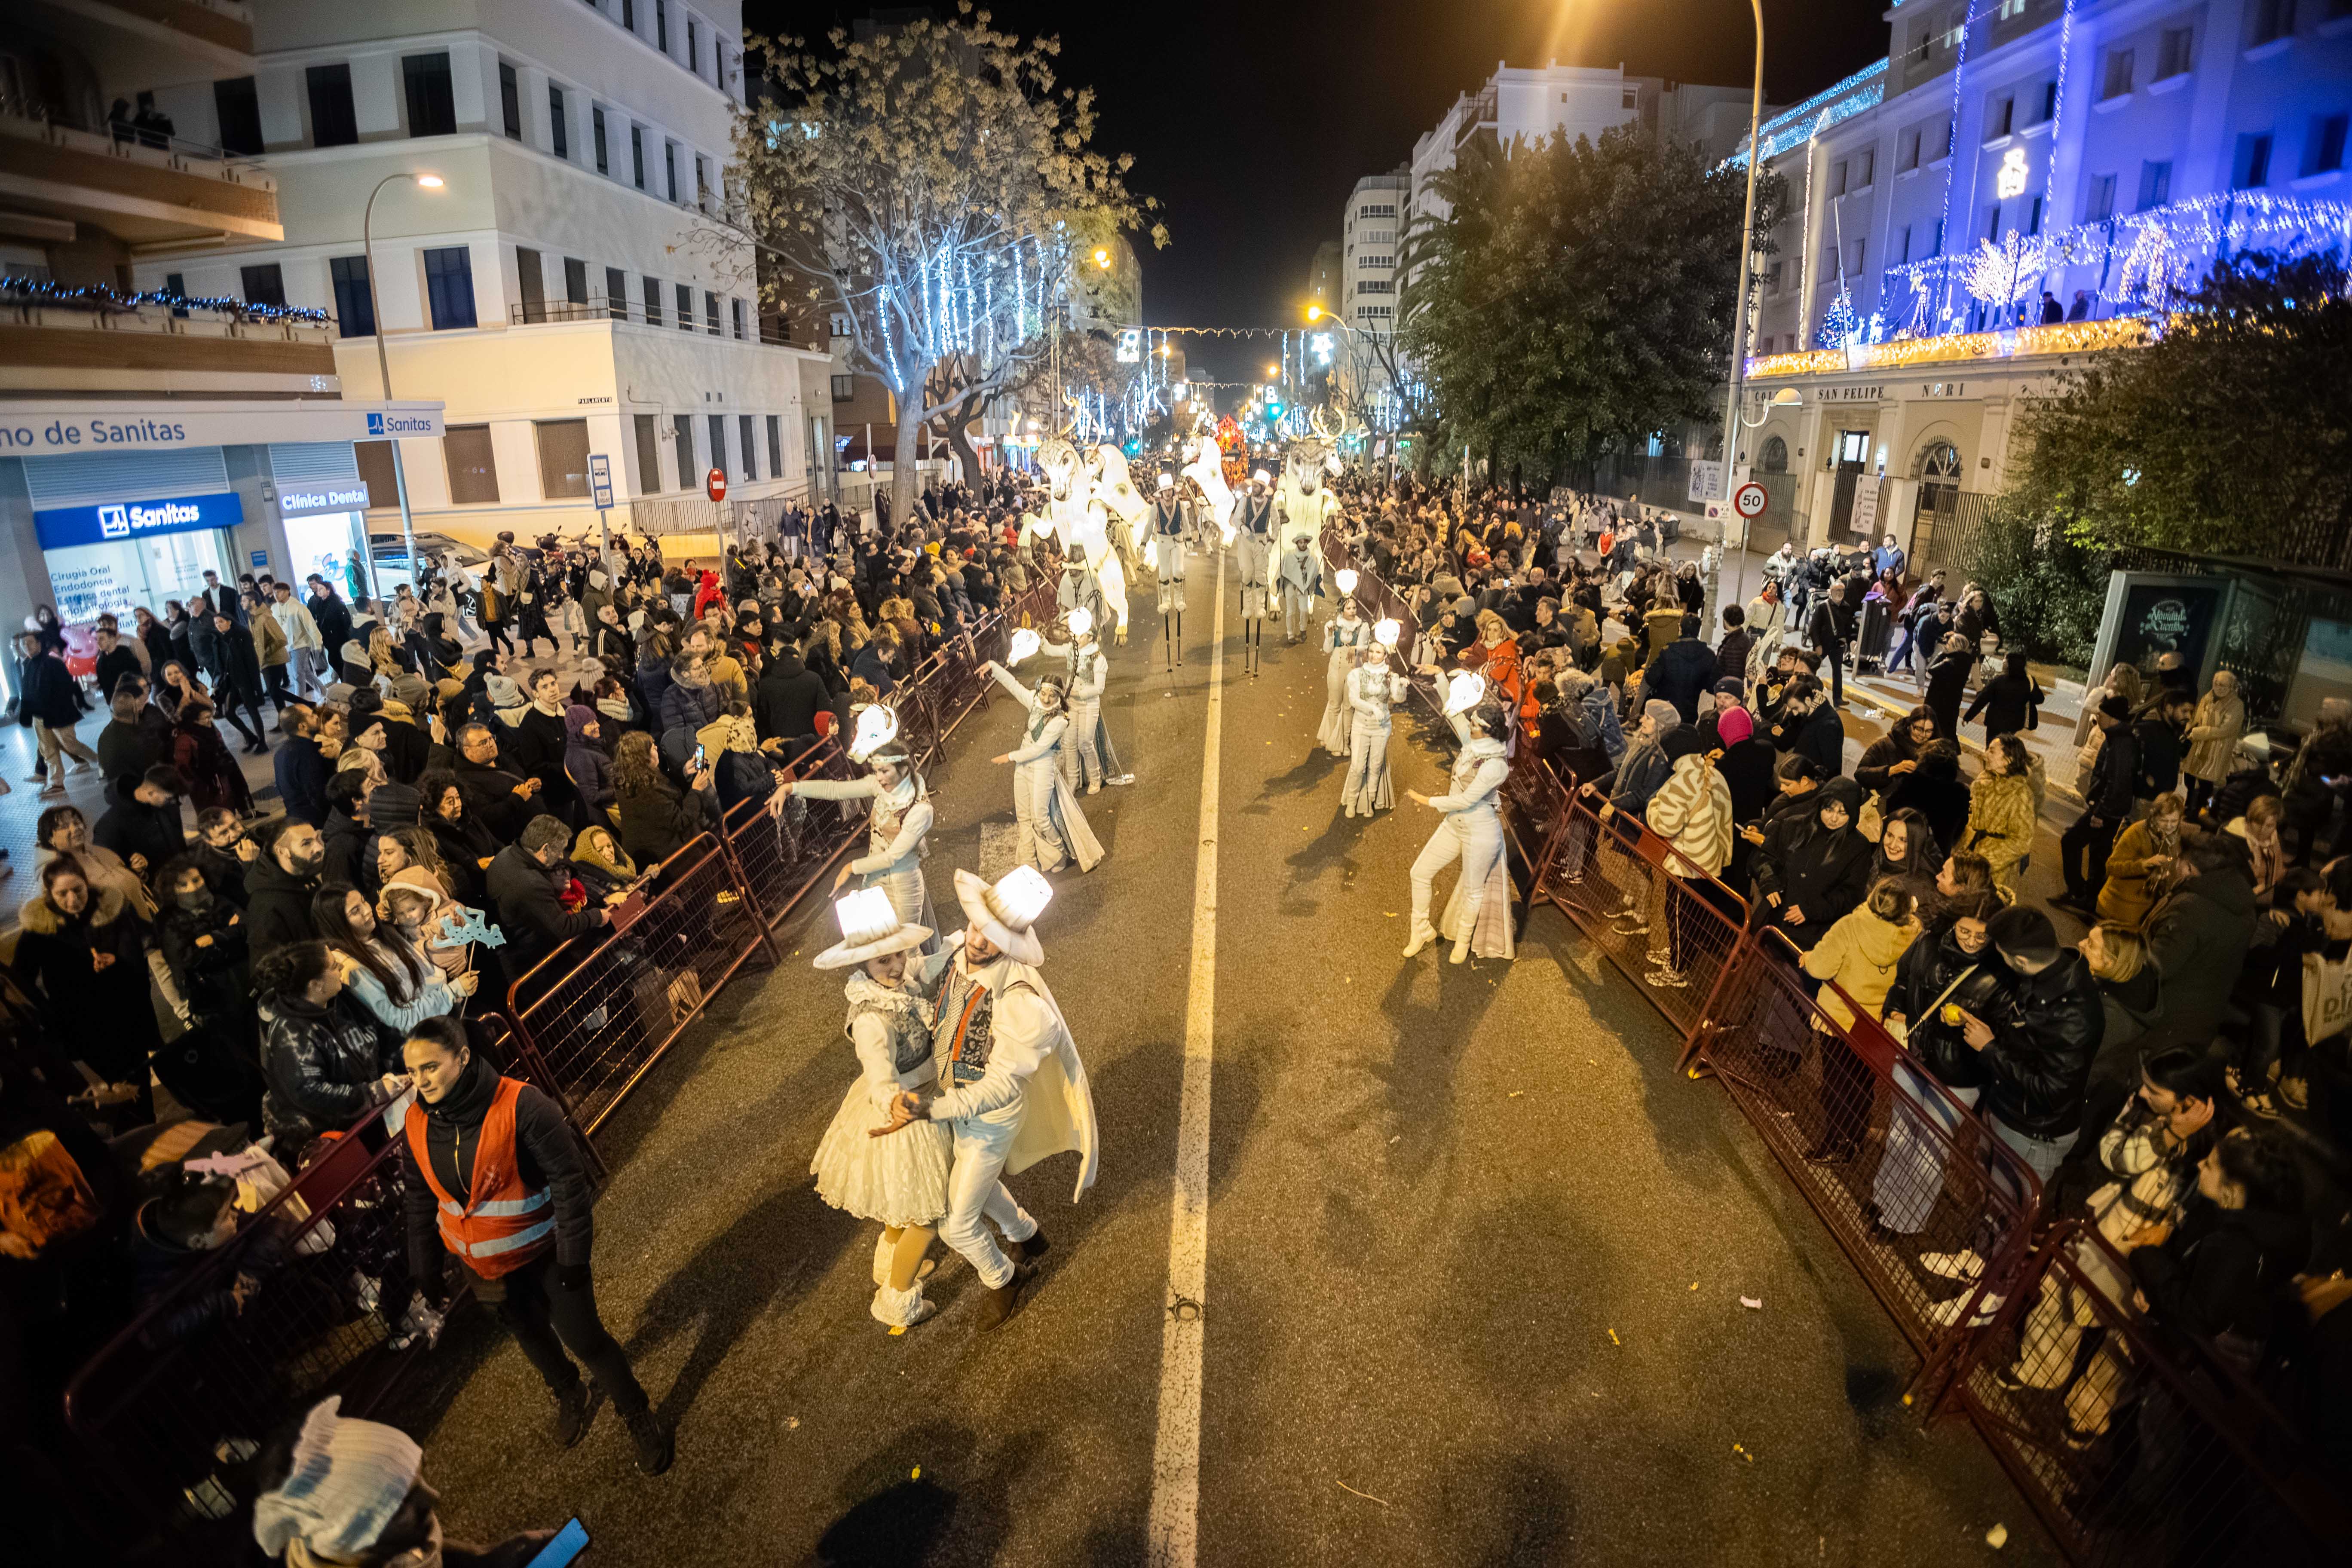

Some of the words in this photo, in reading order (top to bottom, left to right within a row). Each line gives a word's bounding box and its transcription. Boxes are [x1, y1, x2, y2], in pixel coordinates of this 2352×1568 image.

[1818, 388, 1838, 400] SAN
[1844, 387, 1884, 399] FELIPE
[1922, 383, 1964, 397] NERI
[45, 420, 81, 445] de
[91, 418, 185, 443] Sanitas
[387, 416, 431, 432] Sanitas
[282, 493, 327, 510] Clínica
[328, 488, 368, 505] Dental
[1743, 494, 1761, 506] 50
[130, 502, 200, 529] Sanitas
[90, 565, 110, 575] Oral
[100, 586, 130, 598] dental
